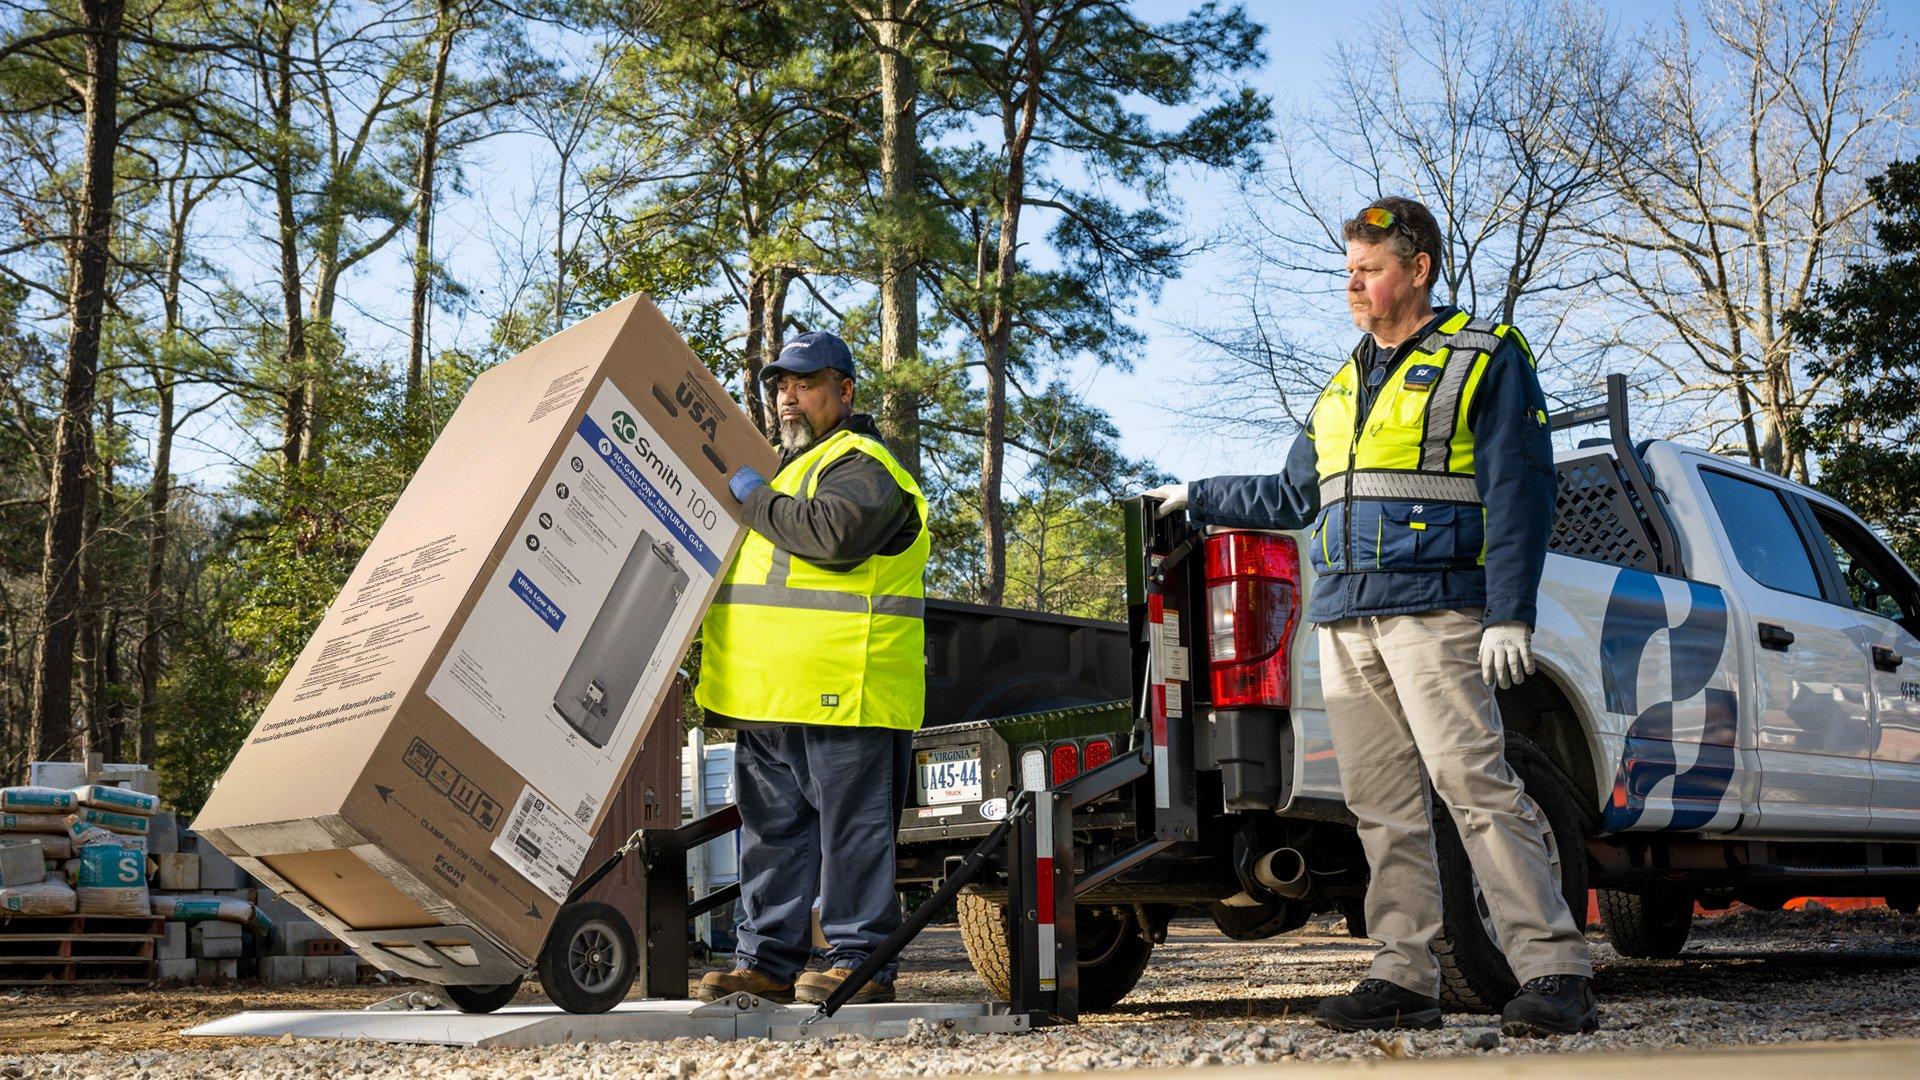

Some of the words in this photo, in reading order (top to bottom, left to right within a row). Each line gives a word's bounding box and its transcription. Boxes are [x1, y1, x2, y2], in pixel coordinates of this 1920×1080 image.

[676, 382, 717, 442] USA
[635, 437, 683, 496] Smith
[687, 489, 717, 531] 100
[646, 498, 666, 521] NATURAL
[655, 498, 688, 536] NATURAL
[687, 532, 704, 553] GAS
[516, 576, 533, 595] Ultra
[532, 591, 547, 608] Low
[251, 733, 276, 745] Manual
[316, 716, 347, 731] completo
[364, 704, 392, 717] interior
[262, 718, 296, 732] Complete
[299, 706, 339, 723] Installation
[338, 698, 370, 714] Manual
[370, 690, 396, 704] Inside
[934, 750, 970, 761] VIRGINIA
[118, 857, 139, 883] S
[420, 819, 445, 841] CLAMP
[445, 838, 470, 861] BELOW
[468, 856, 483, 873] THIS
[483, 869, 500, 885] LINE
[435, 854, 466, 883] Front
